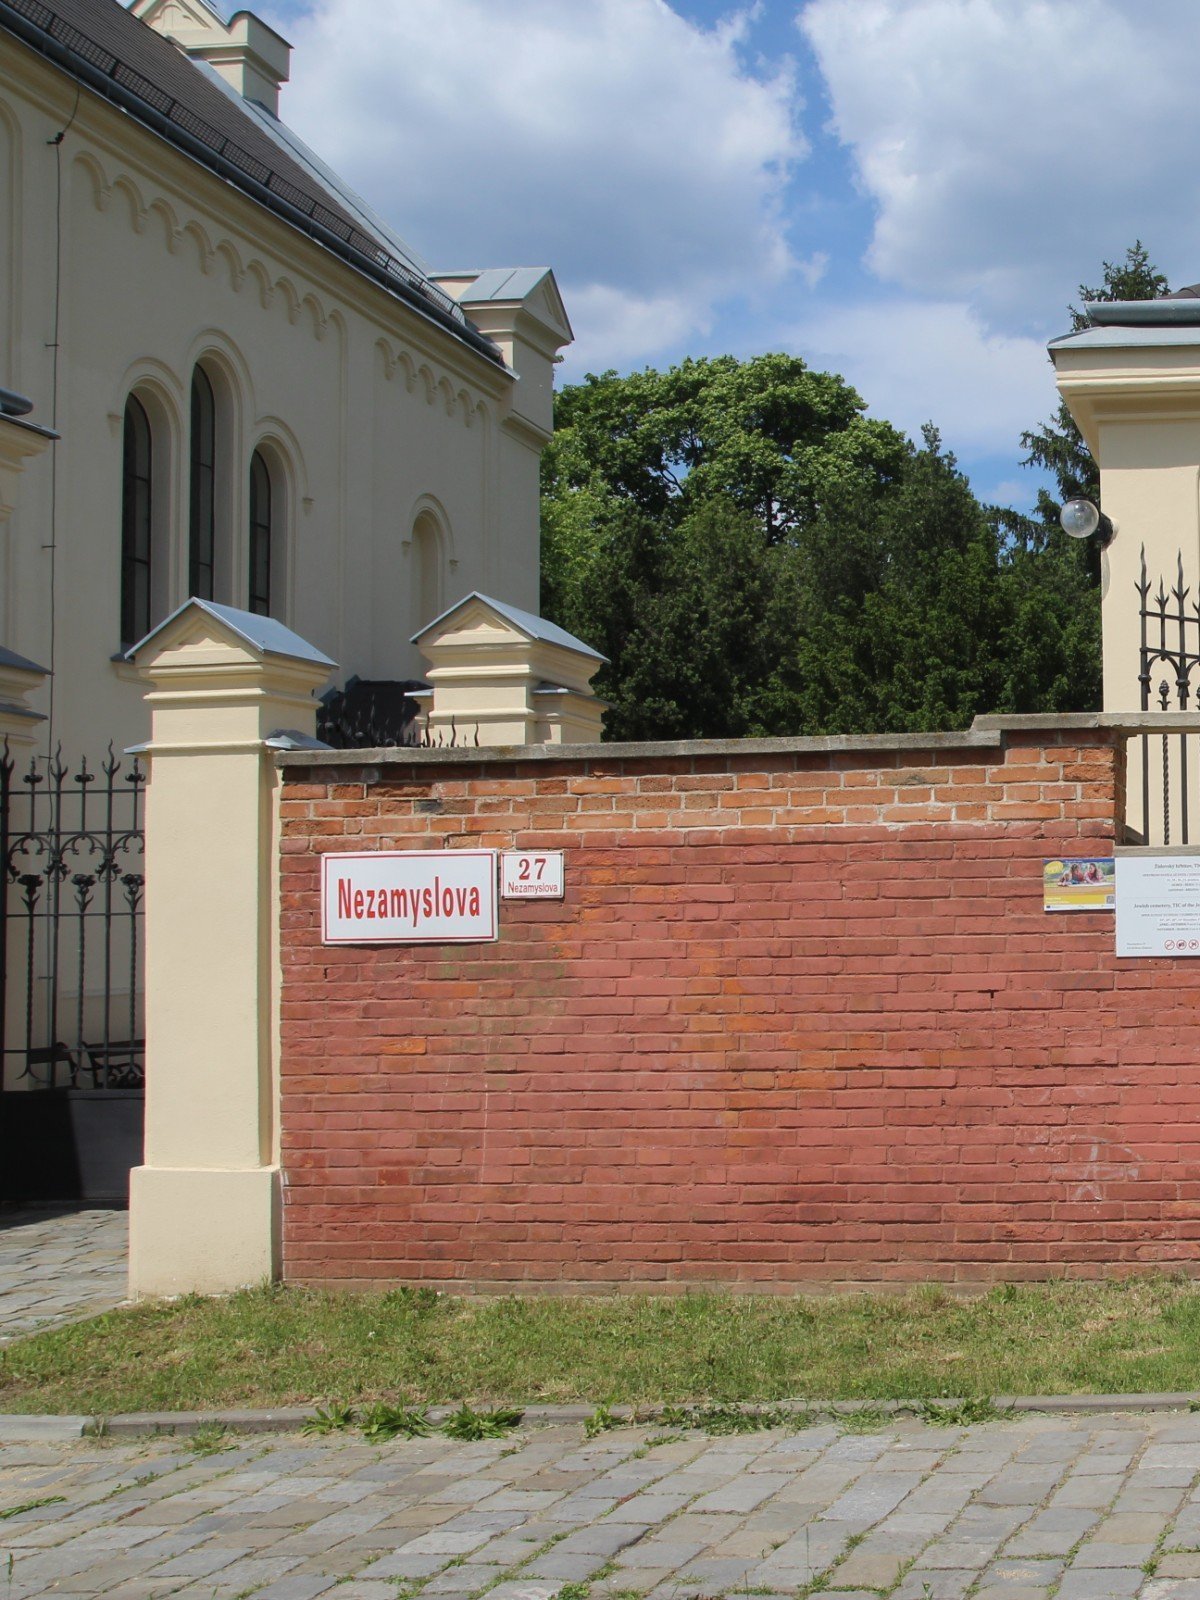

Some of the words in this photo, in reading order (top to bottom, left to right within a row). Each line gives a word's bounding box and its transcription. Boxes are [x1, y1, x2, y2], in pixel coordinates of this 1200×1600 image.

[518, 858, 547, 880] 27
[508, 881, 558, 895] Nezamyslova
[338, 876, 480, 927] Nezamyslova
